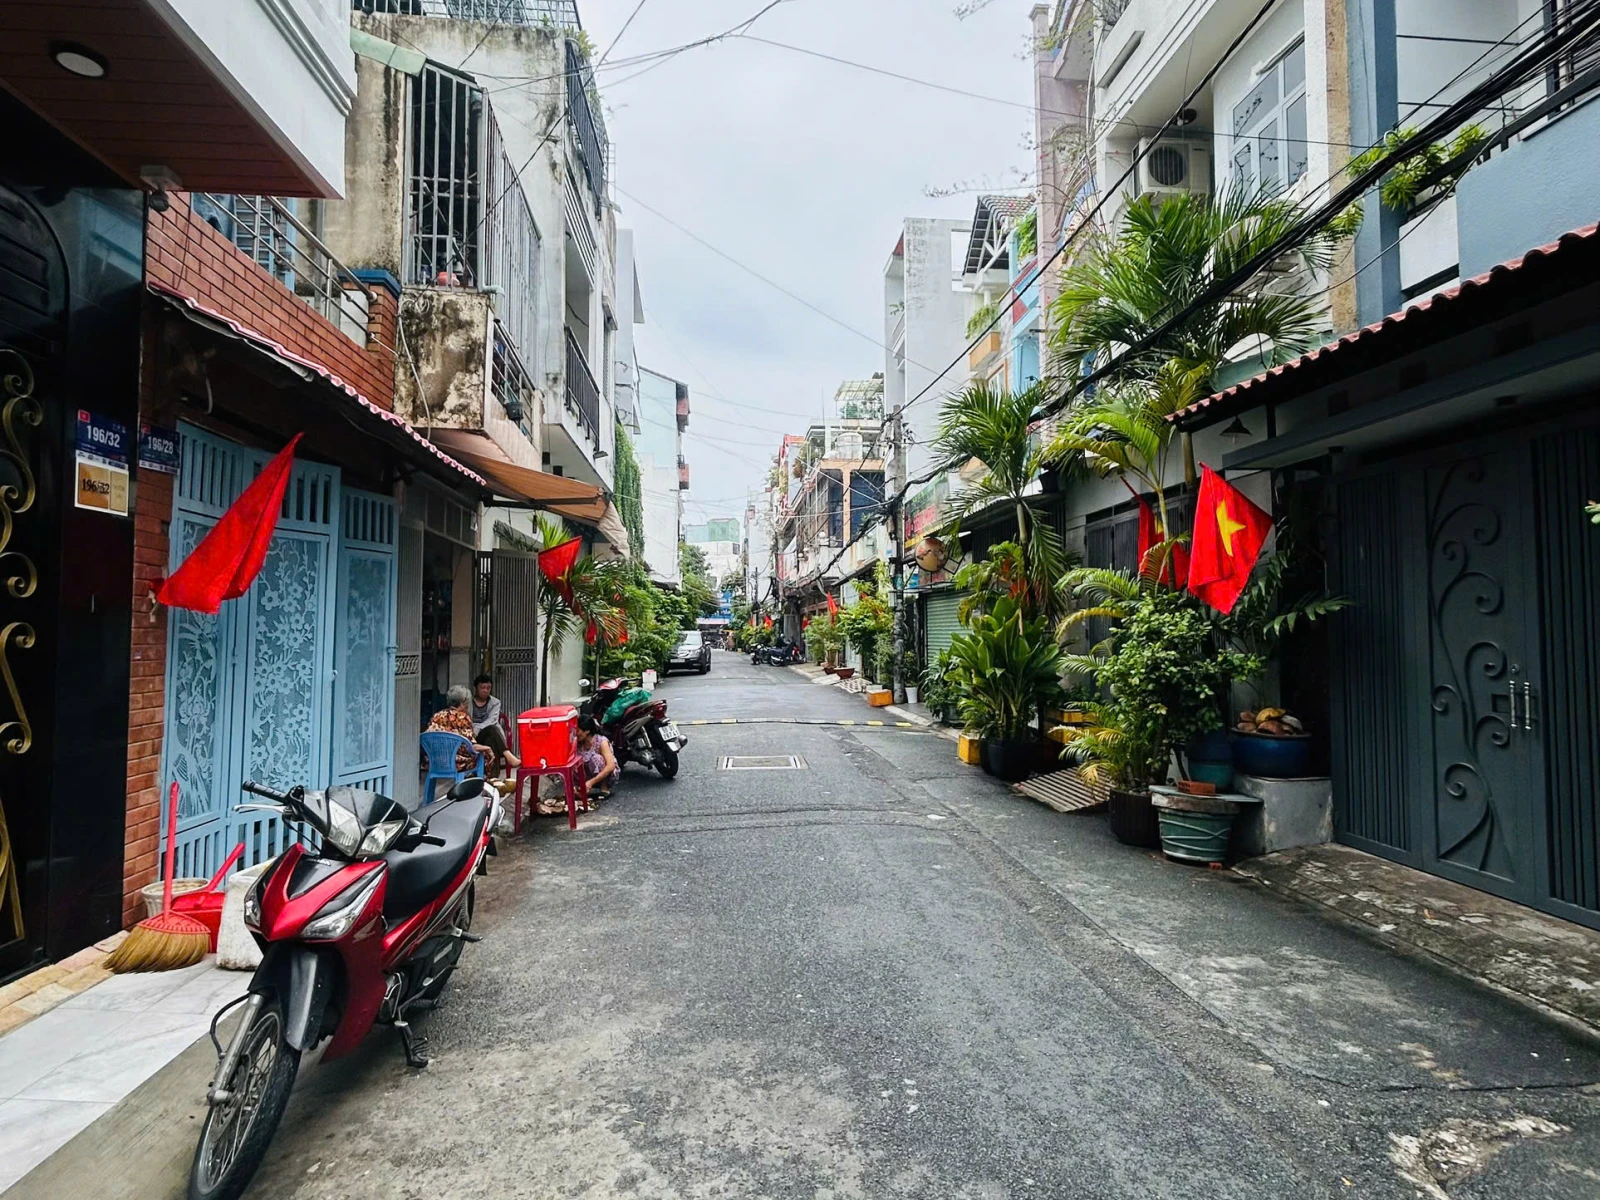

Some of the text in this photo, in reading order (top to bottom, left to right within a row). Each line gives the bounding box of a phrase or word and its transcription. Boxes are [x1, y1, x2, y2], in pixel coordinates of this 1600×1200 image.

[87, 425, 120, 448] 196/32
[148, 436, 174, 454] 196/28
[82, 478, 109, 494] 196/32
